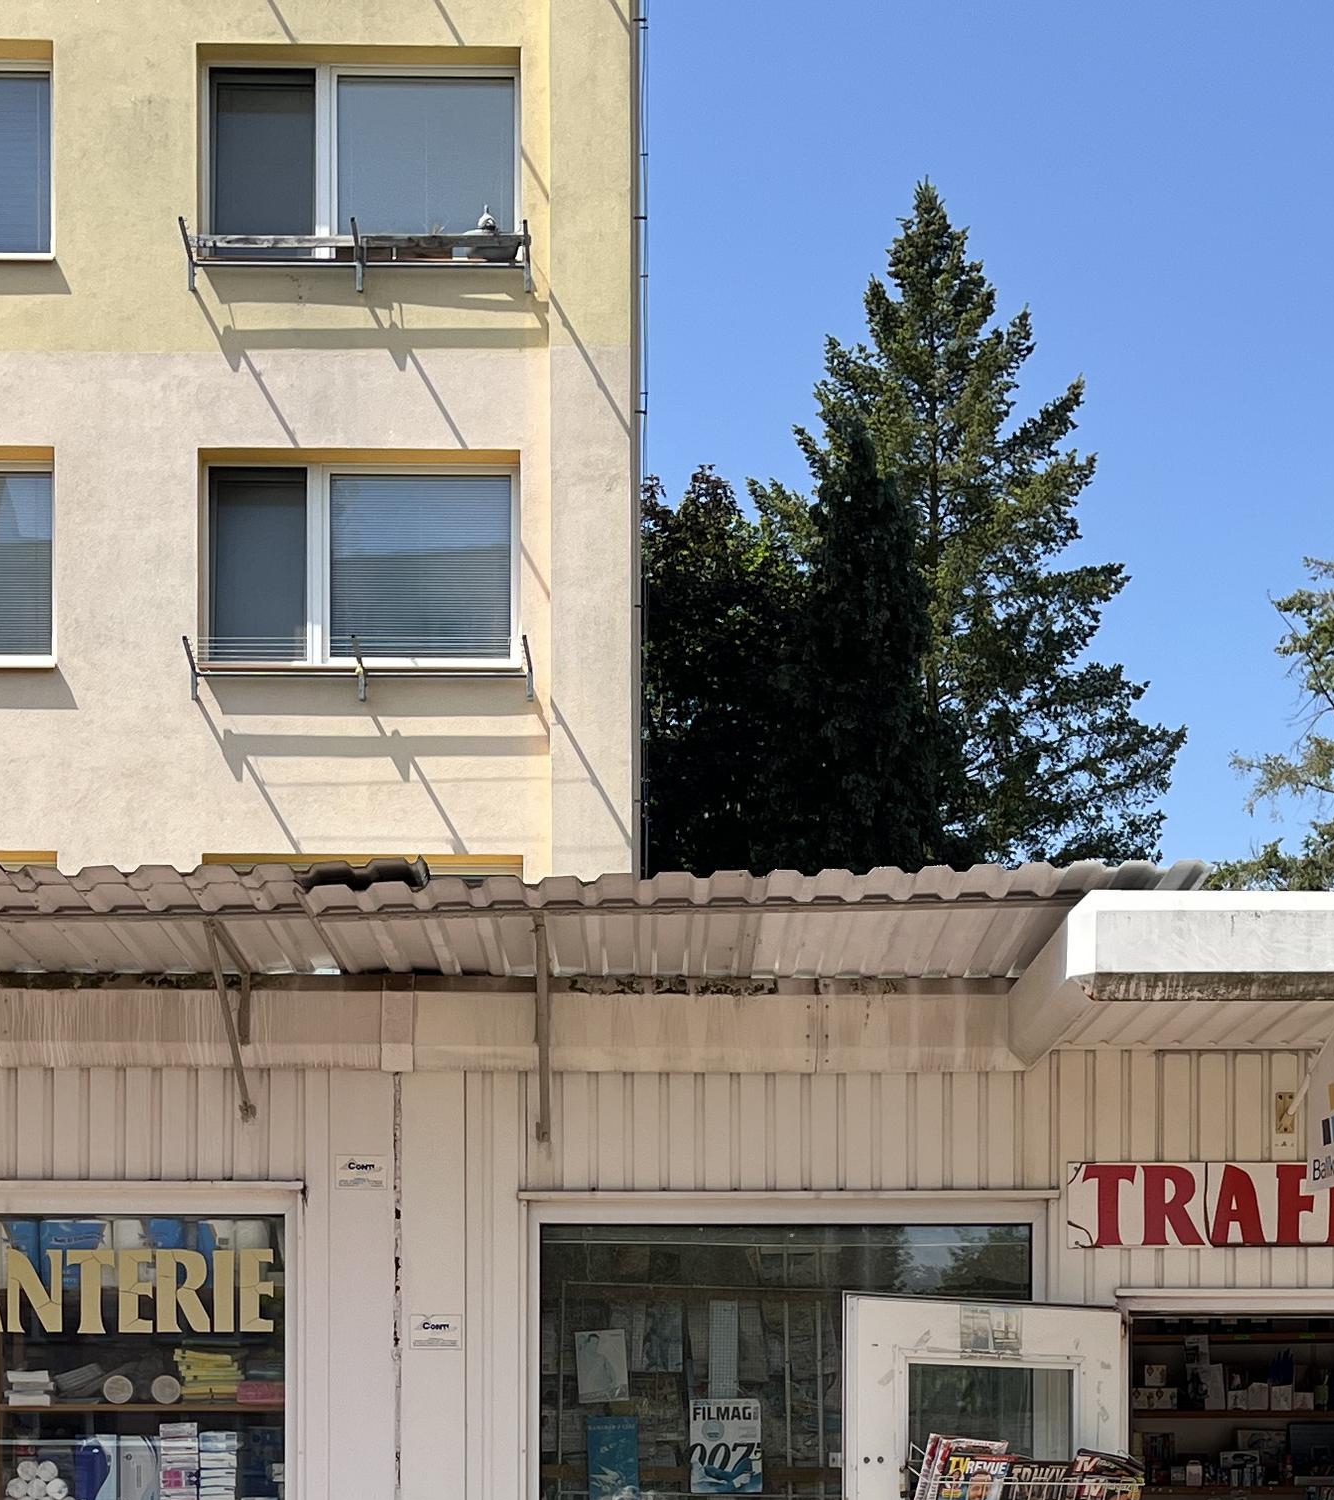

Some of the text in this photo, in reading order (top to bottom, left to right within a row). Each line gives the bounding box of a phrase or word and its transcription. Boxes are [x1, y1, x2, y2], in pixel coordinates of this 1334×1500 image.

[692, 1406, 752, 1421] FILMAG
[949, 1456, 1007, 1476] TV REVUE
[1076, 1455, 1100, 1472] TV
